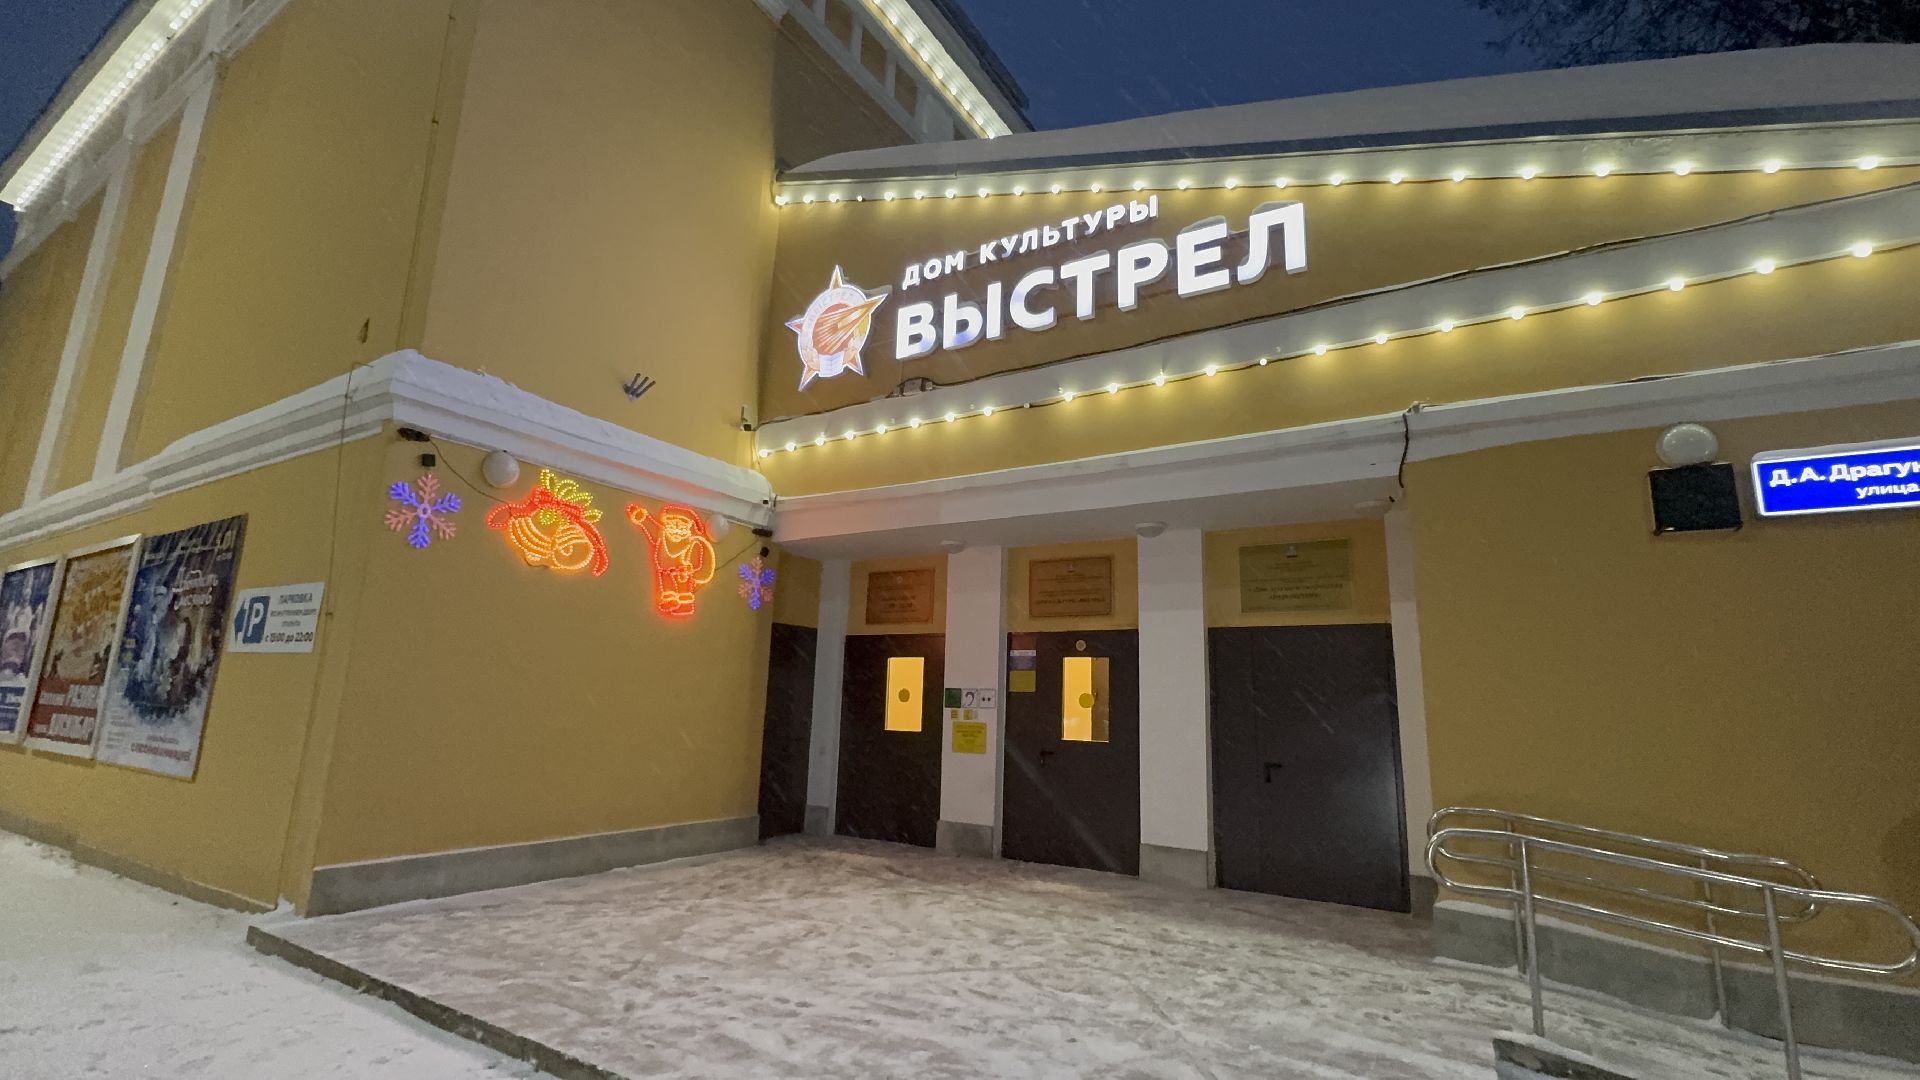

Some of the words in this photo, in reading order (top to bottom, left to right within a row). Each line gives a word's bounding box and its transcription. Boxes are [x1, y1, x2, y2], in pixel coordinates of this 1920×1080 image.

[902, 250, 964, 290] ДОМ
[979, 195, 1158, 264] КУЛЬТУРЫ
[895, 203, 1307, 360] ВЫСТРЕЛ
[1769, 466, 1826, 488] Д.А.
[1856, 482, 1920, 499] улица
